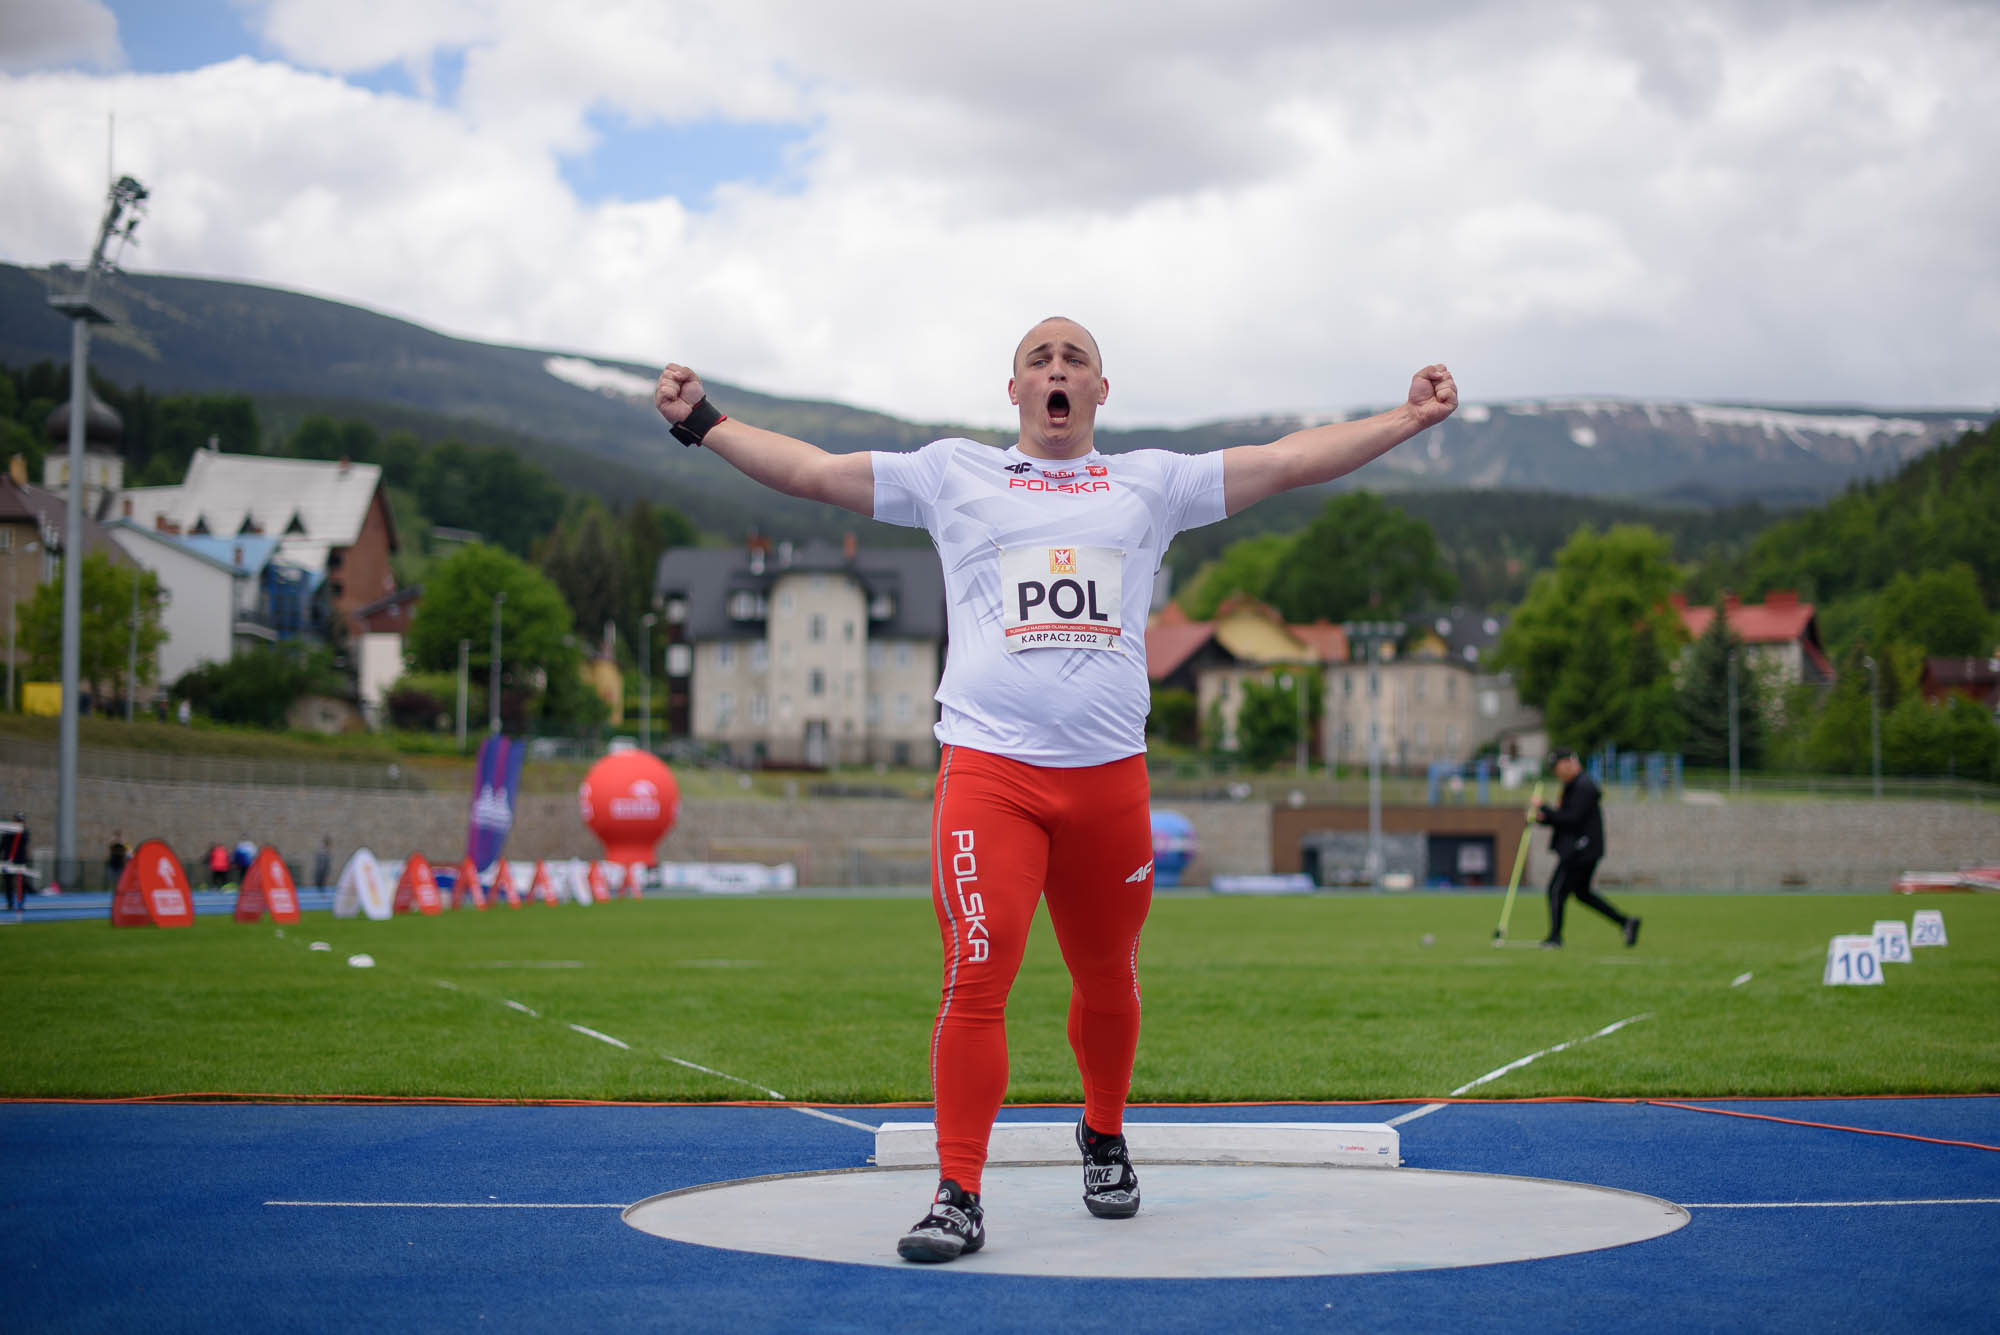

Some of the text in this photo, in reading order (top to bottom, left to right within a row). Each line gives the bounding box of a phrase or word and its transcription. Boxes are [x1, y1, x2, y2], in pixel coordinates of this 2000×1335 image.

[1009, 478, 1110, 494] POLSKA
[1018, 578, 1109, 621] POL
[1021, 633, 1097, 644] KARPACZ 2022
[952, 829, 989, 962] POLSKA
[1917, 920, 1941, 943] 20
[1875, 935, 1905, 959] 15
[1838, 951, 1875, 980] 10
